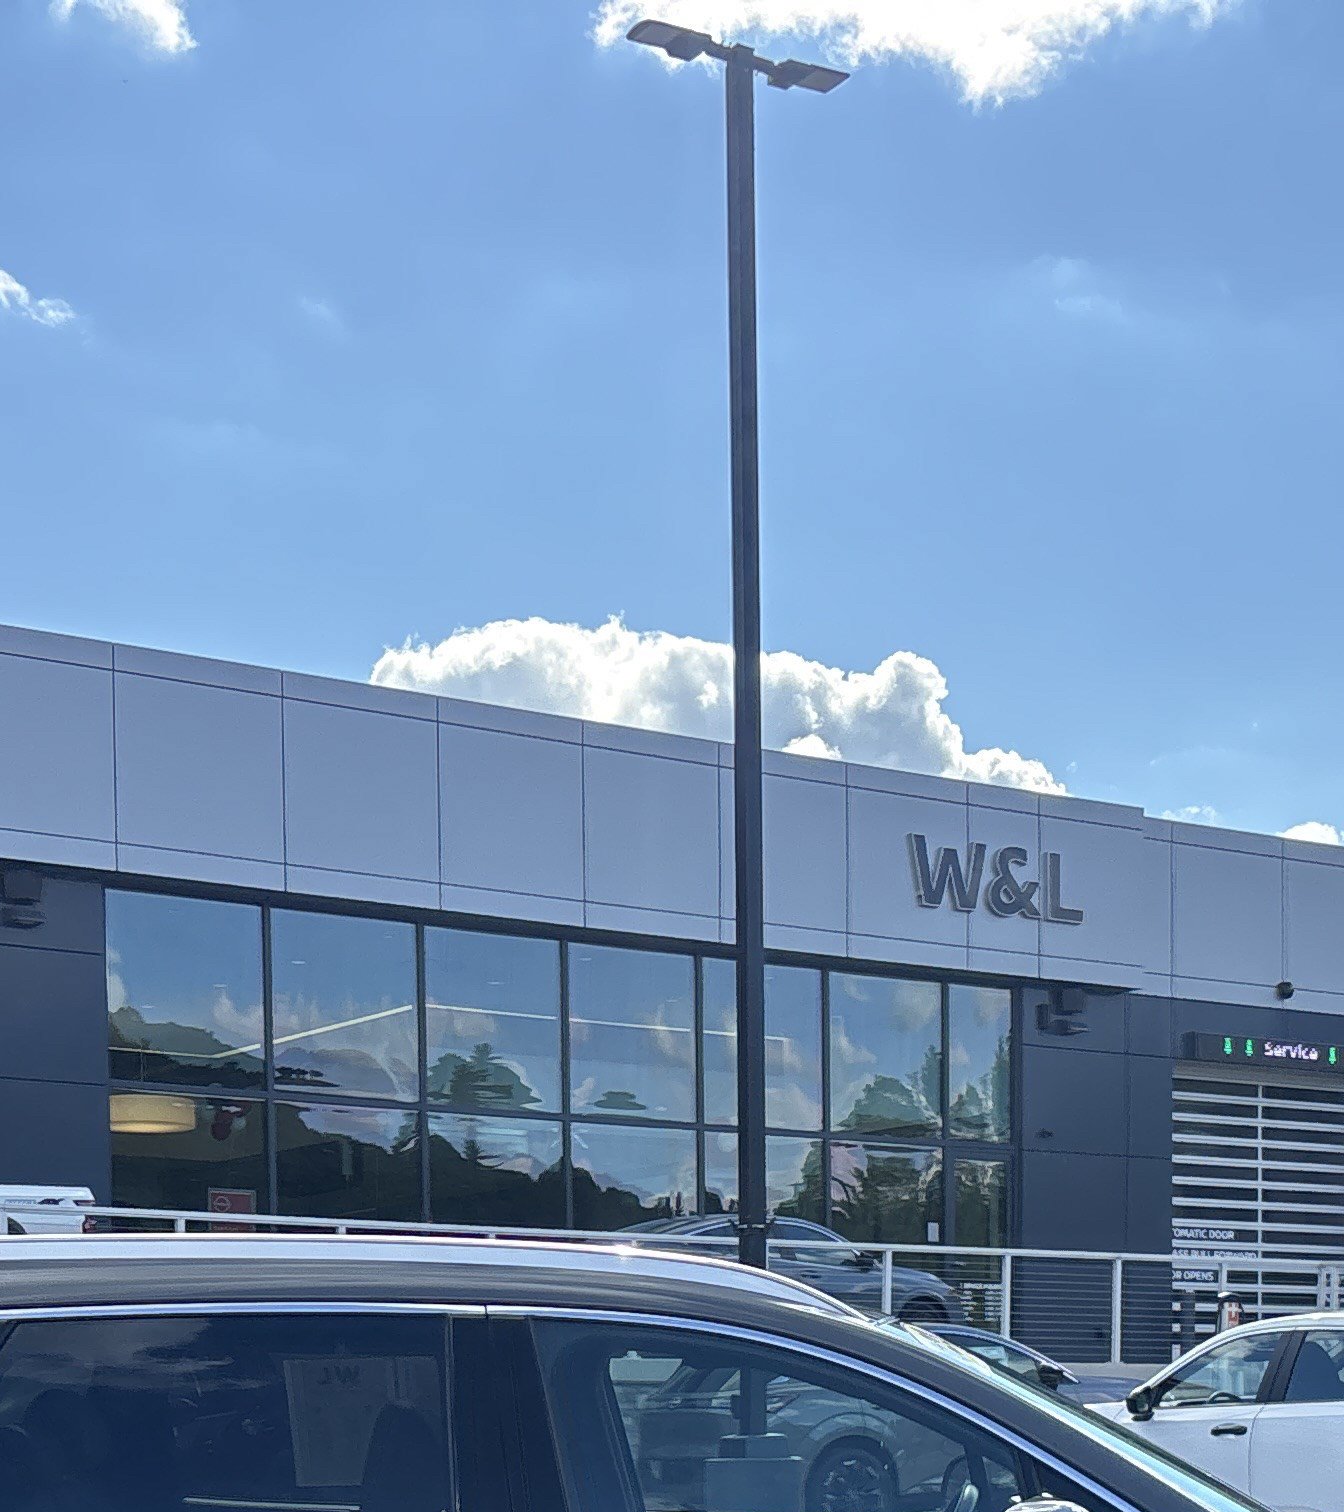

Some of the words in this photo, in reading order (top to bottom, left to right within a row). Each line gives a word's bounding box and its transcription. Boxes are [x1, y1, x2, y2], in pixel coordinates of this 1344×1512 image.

[907, 832, 1086, 925] W&L
[1264, 1042, 1318, 1060] Service
[1209, 1229, 1235, 1240] DOOR
